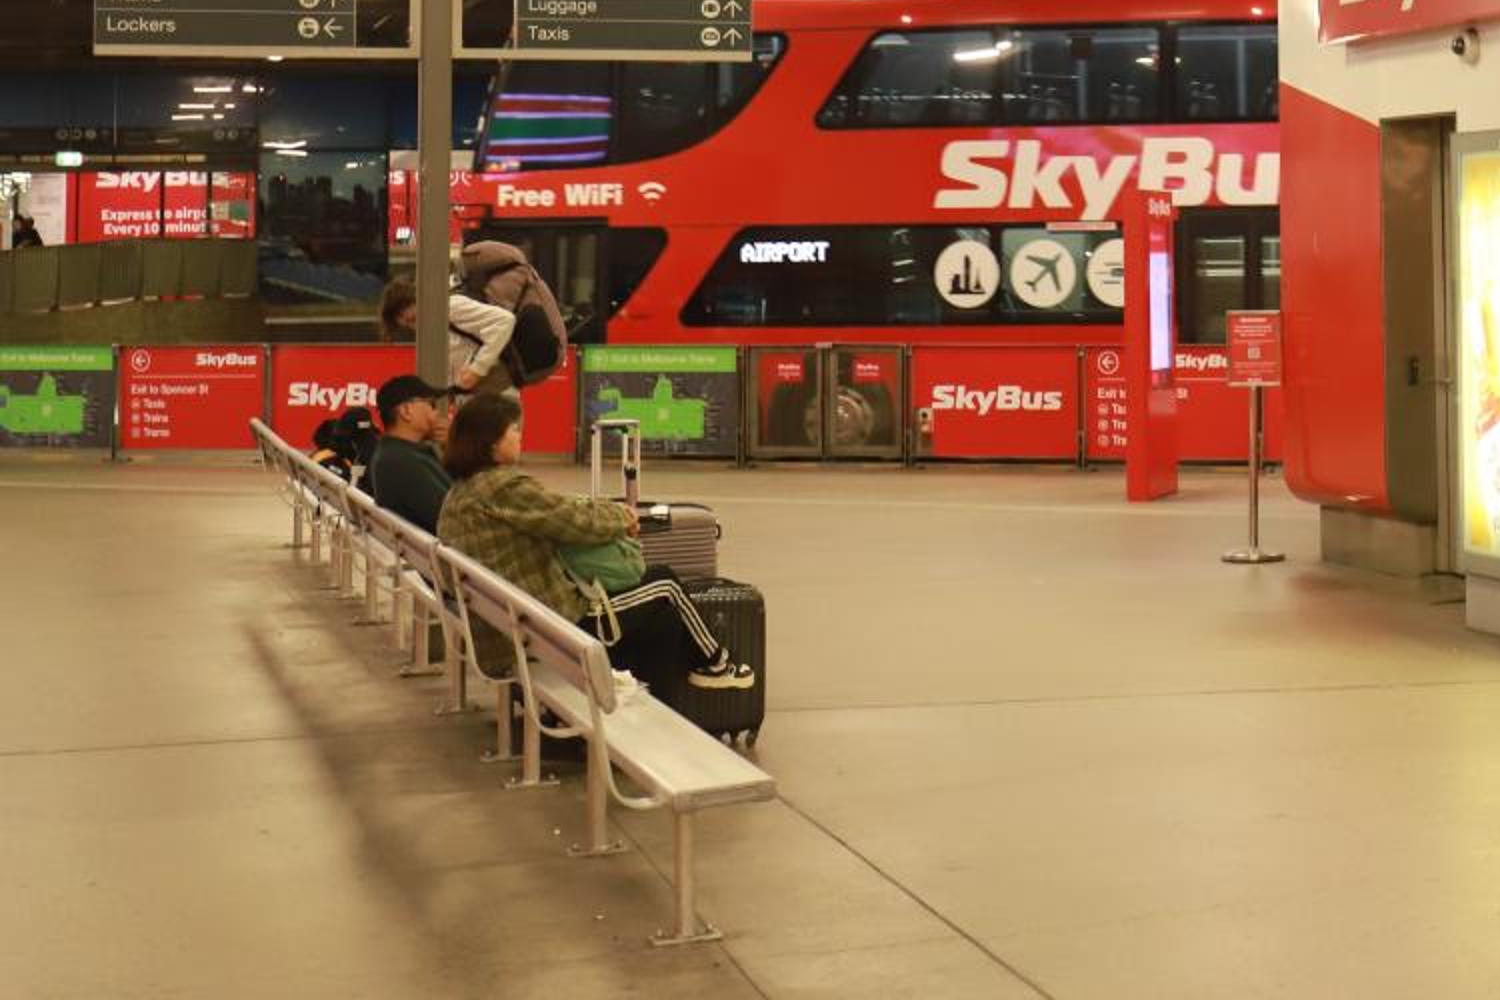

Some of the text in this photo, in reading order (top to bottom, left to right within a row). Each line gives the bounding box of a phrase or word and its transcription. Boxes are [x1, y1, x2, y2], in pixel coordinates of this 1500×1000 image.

[107, 16, 176, 32] Lockers
[528, 25, 570, 41] Taxis
[933, 137, 1280, 222] SkyBu
[498, 184, 623, 206] Free WiFi
[103, 223, 143, 236] Every
[740, 242, 831, 263] AIRPORT
[195, 352, 257, 368] SkyBus
[932, 385, 1062, 415] SkyBus
